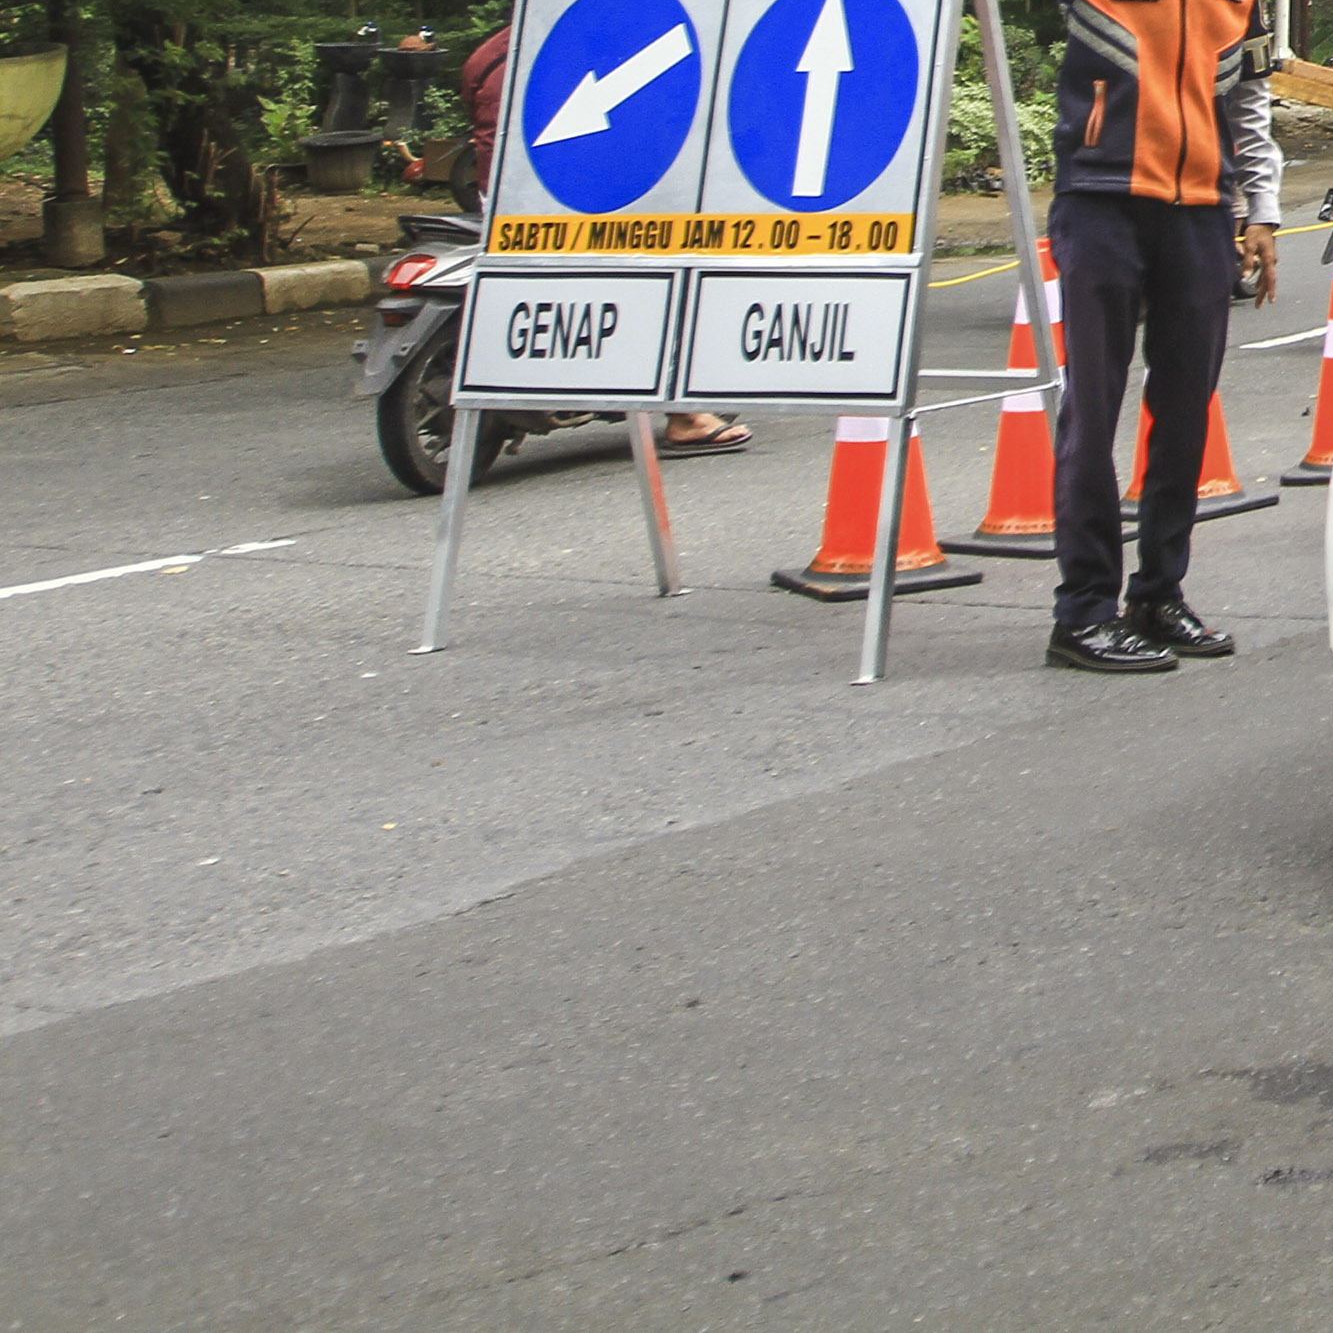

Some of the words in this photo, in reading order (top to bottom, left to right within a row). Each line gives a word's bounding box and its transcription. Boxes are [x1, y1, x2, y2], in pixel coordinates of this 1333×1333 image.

[497, 221, 568, 252] SABTU
[586, 220, 674, 252] MINGGU
[680, 219, 727, 251] JAM
[506, 301, 619, 361] GENAP
[740, 301, 857, 363] GANJIL
